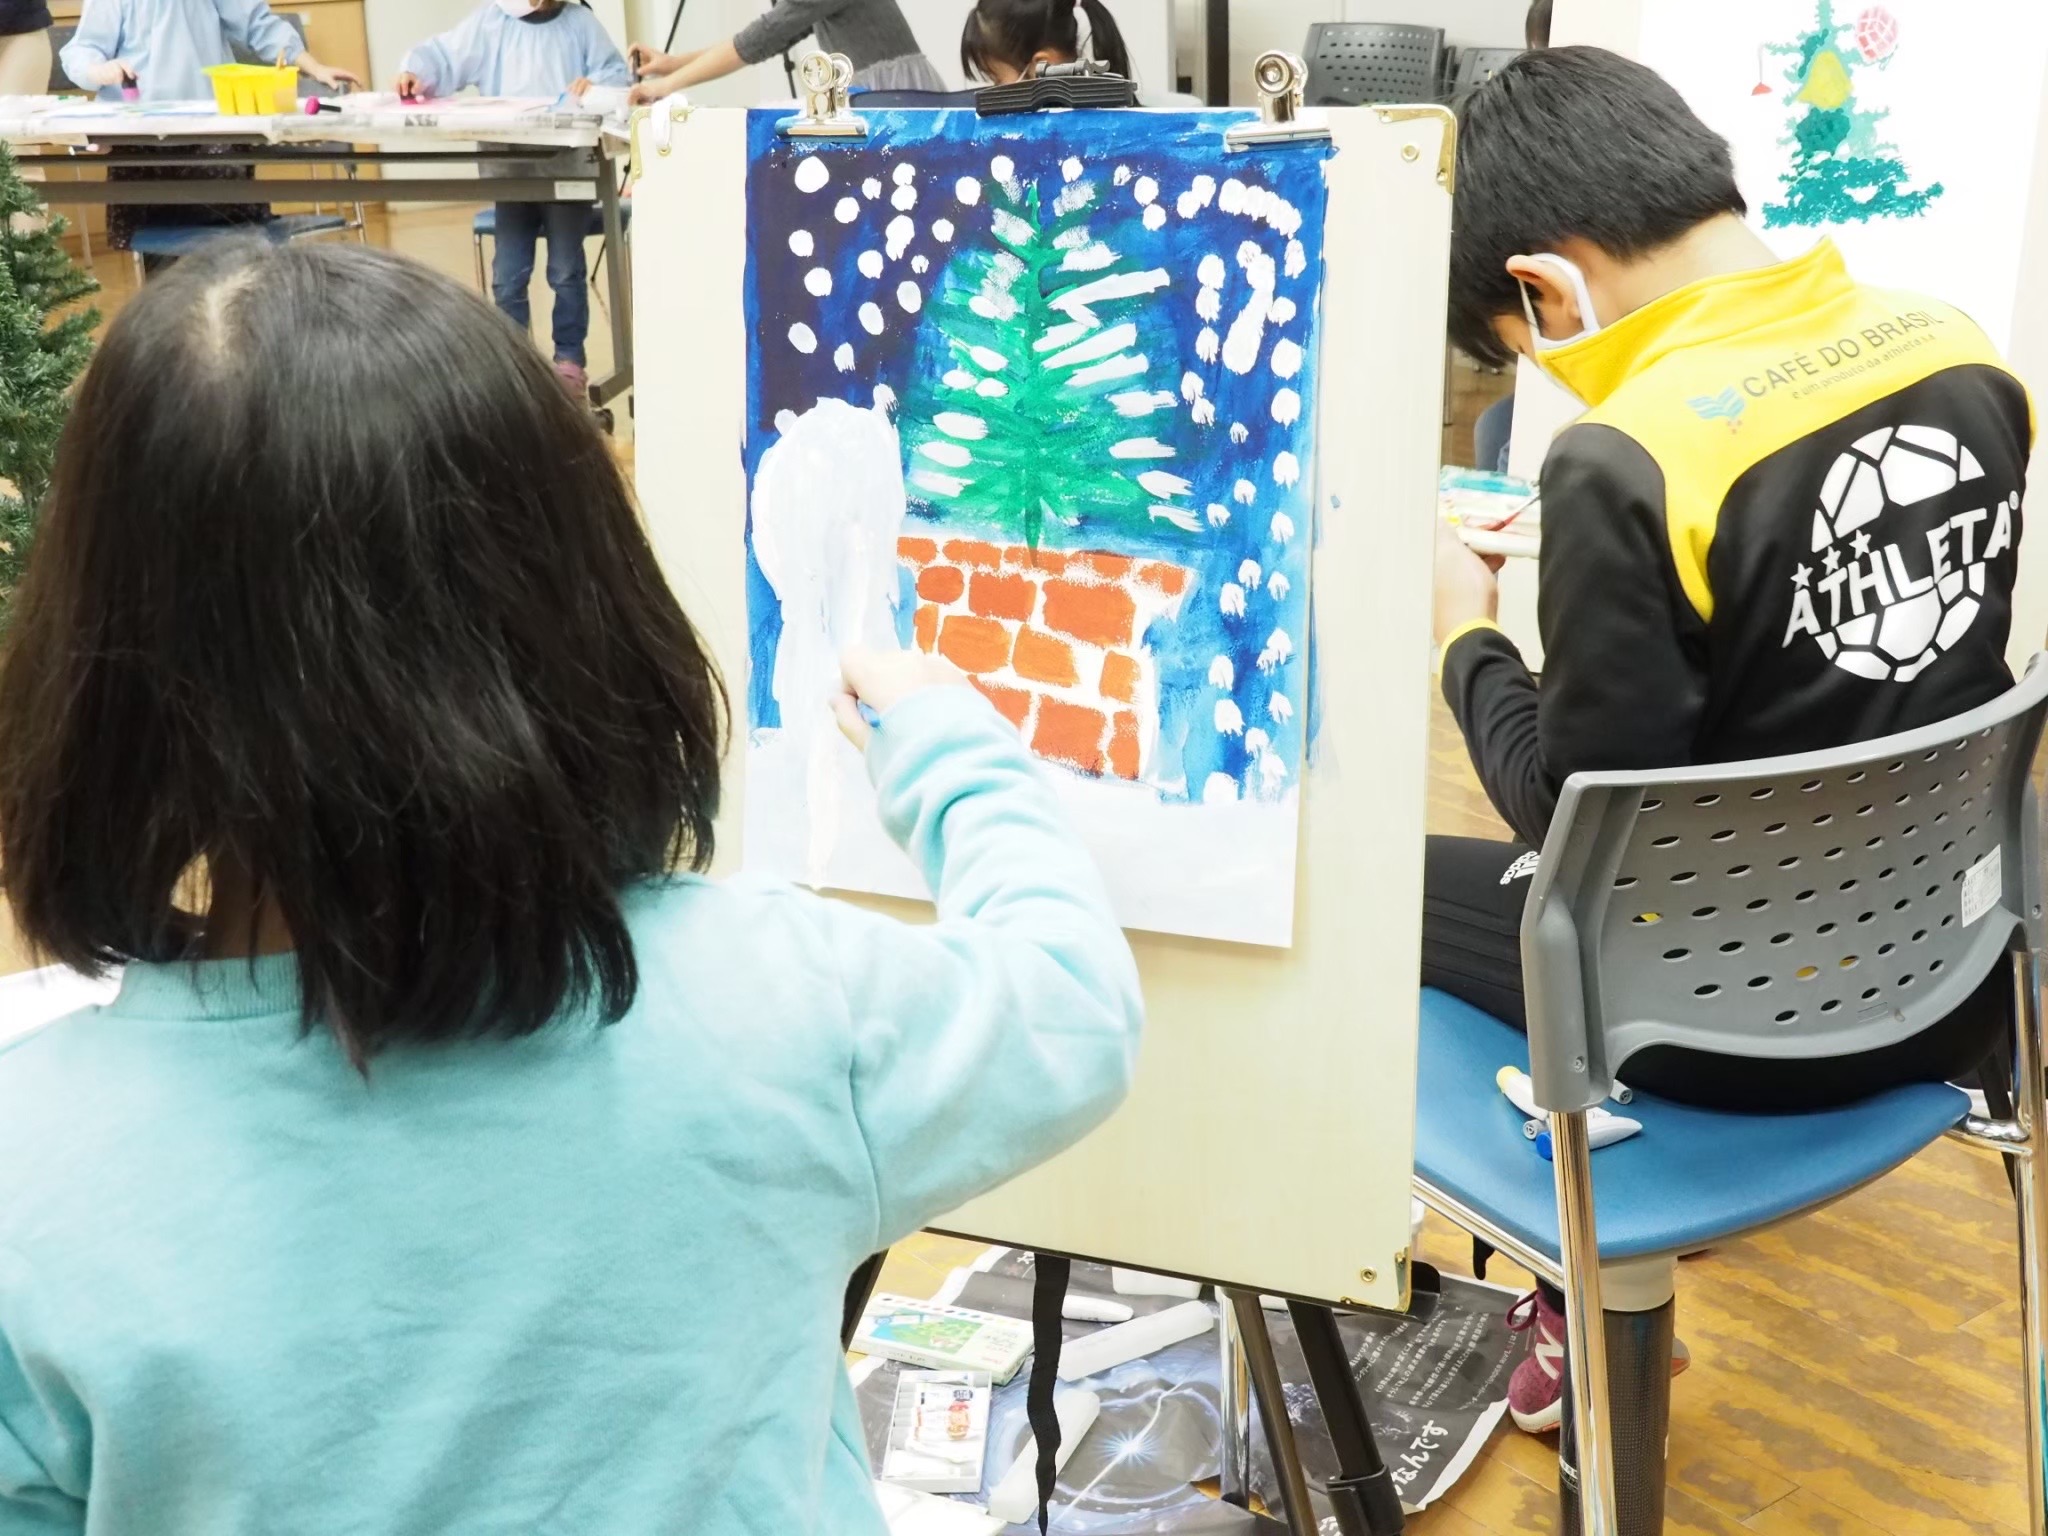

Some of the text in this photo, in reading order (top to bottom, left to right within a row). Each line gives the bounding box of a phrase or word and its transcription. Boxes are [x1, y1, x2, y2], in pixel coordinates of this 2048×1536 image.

[1801, 382, 1821, 395] um
[1822, 365, 1864, 388] produto
[1866, 356, 1881, 368] da
[1883, 337, 1921, 362] athleta
[1818, 338, 1861, 367] DO
[1860, 310, 1944, 348] BRASIL
[1390, 1420, 1449, 1496] なんです
